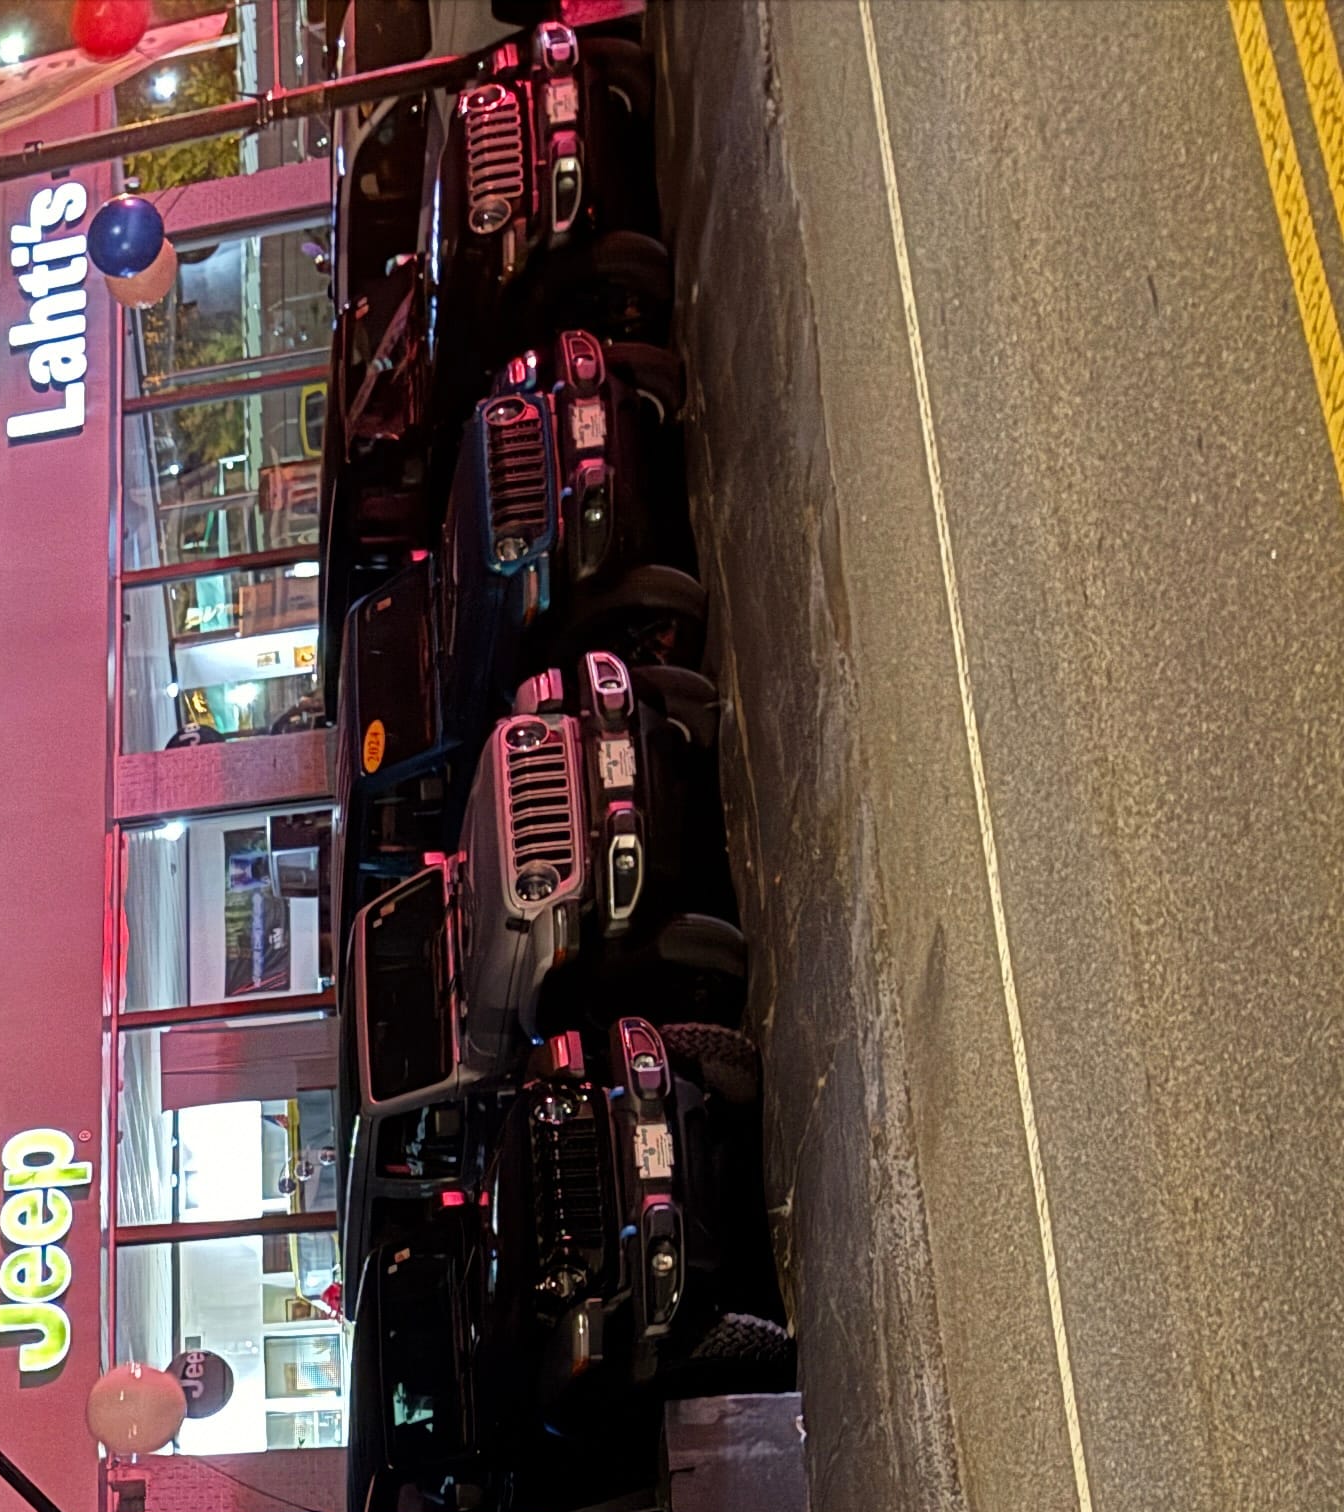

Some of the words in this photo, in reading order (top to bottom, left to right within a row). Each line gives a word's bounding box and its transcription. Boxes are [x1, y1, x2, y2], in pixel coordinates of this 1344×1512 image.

[6, 182, 87, 438] Lahti's
[367, 732, 381, 762] 2024
[178, 1352, 205, 1399] Jee
